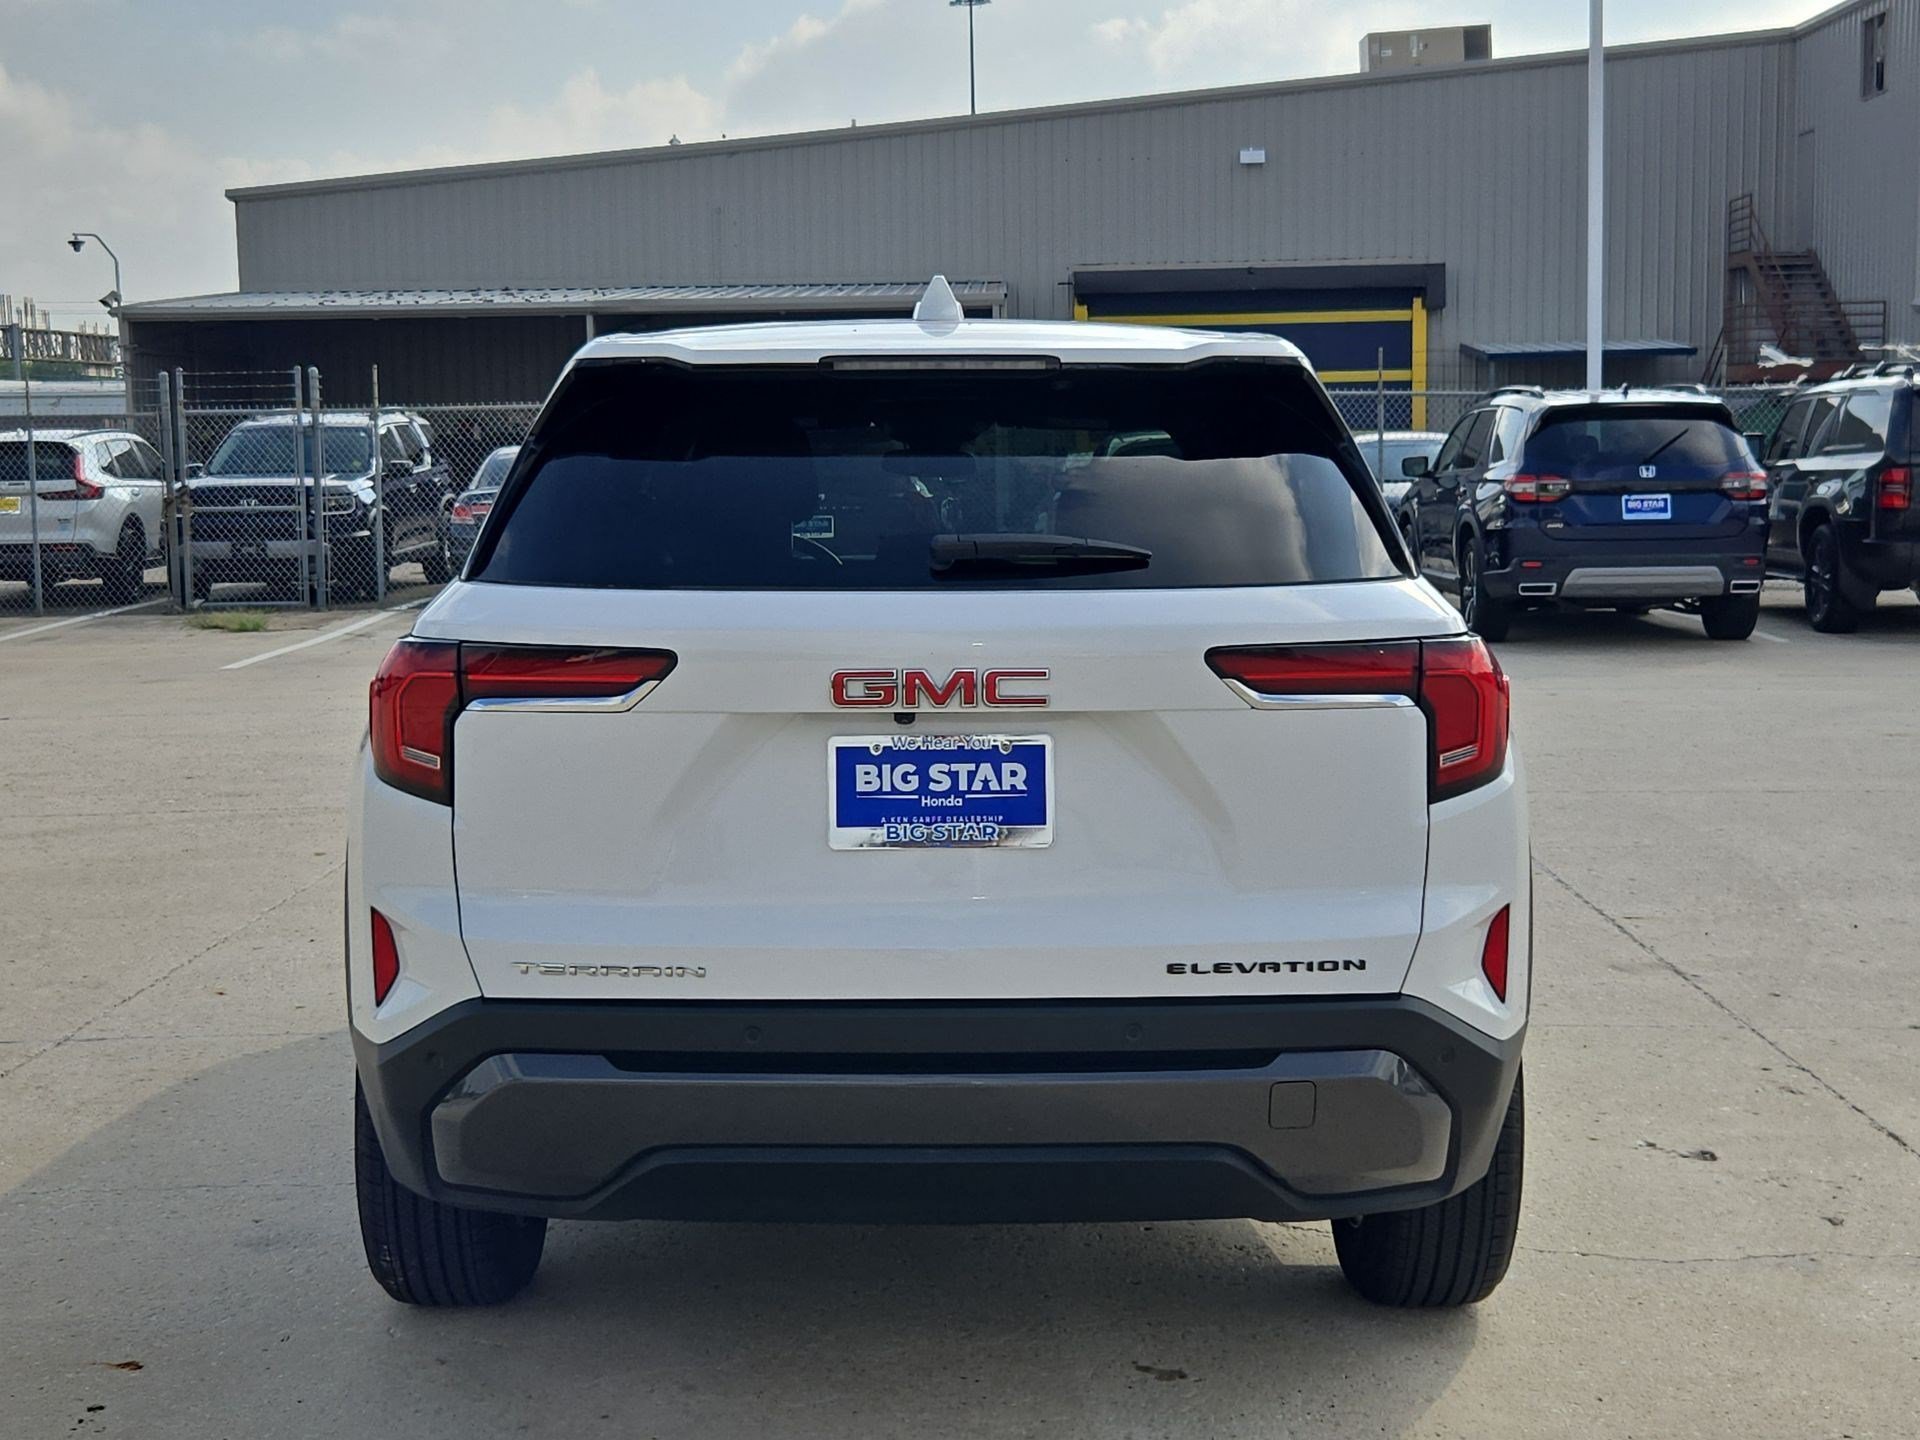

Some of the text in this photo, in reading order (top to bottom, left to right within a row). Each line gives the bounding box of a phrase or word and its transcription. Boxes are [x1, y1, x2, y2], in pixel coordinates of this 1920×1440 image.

[1643, 500, 1665, 509] STAR
[831, 668, 1050, 708] GMC
[891, 735, 992, 750] We Hear You
[855, 763, 1027, 792] BIG STAR
[921, 795, 963, 807] Honda
[946, 815, 1004, 823] DEALERSHIP
[885, 823, 998, 841] BIG STAR
[511, 961, 706, 977] TERRAIN
[1166, 959, 1366, 974] ELEVATION
